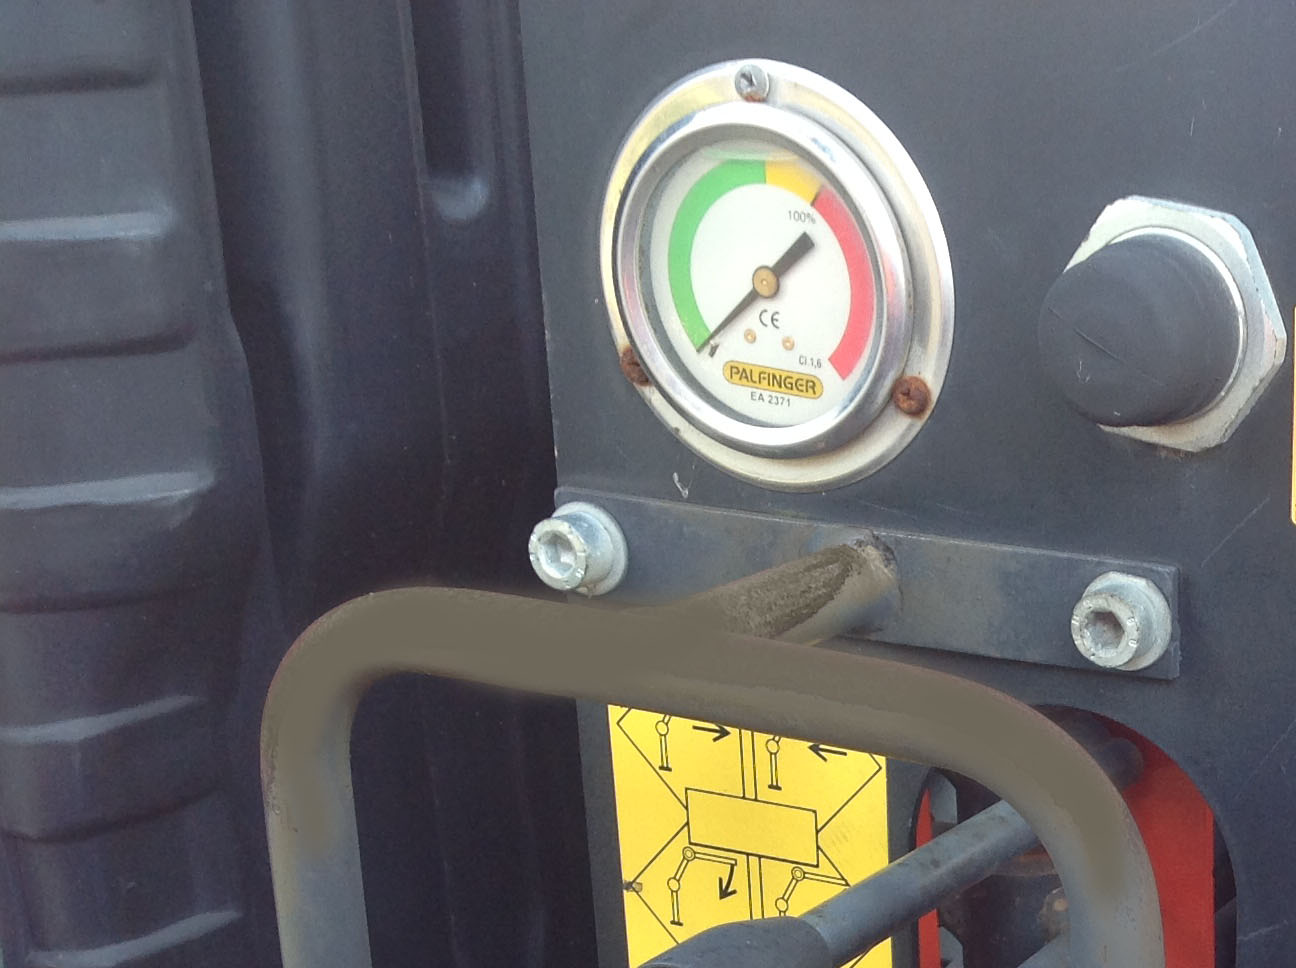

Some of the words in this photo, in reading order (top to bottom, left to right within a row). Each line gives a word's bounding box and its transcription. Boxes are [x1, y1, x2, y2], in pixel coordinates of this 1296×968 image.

[787, 209, 817, 225] 100%
[728, 364, 818, 396] PALFINGER
[750, 391, 765, 403] EA
[767, 394, 791, 408] 2371
